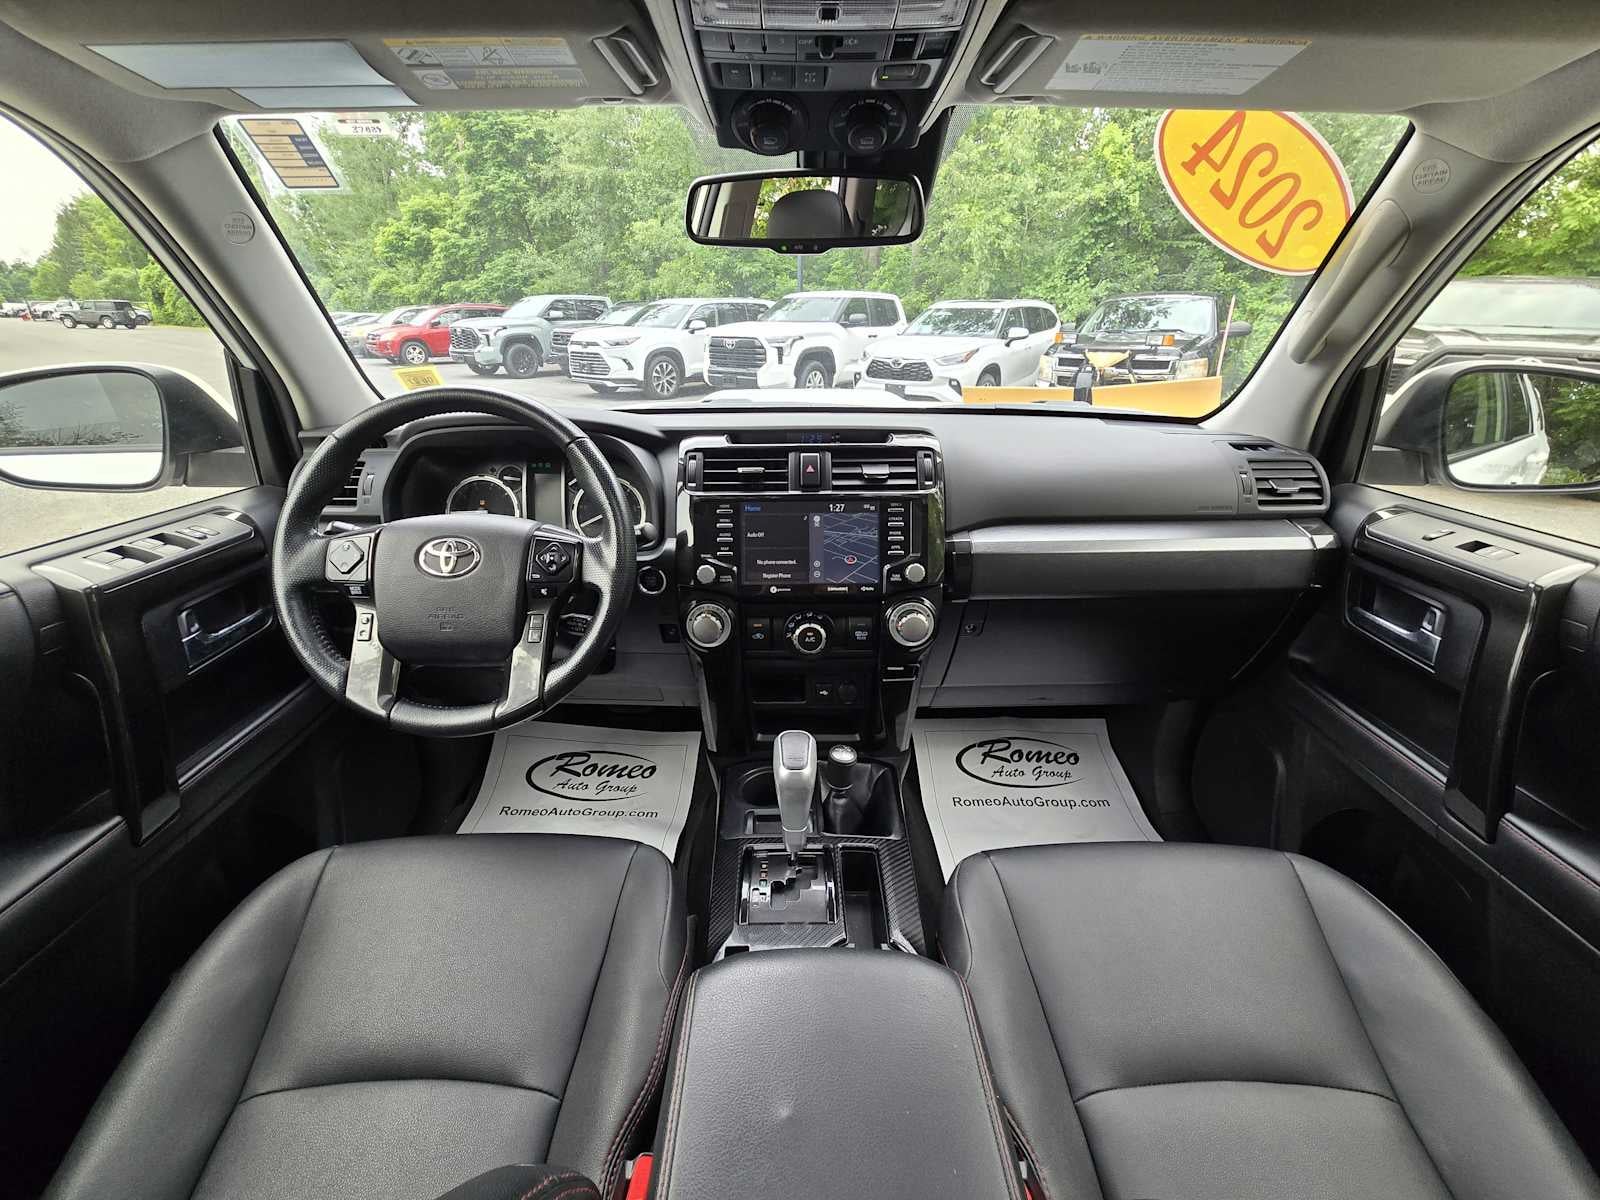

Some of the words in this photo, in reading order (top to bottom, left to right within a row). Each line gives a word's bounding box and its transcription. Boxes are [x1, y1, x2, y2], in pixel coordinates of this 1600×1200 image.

[829, 504, 845, 512] 1:27
[977, 739, 1080, 766] Romeo
[550, 751, 657, 779] Romeo
[991, 766, 1026, 777] Auto
[1031, 766, 1073, 782] Group
[552, 778, 589, 790] Auto
[595, 780, 638, 796] Group
[952, 796, 1111, 810] RomeoAutoGroup.com
[499, 806, 659, 819] RomeoAutoGroup.com
